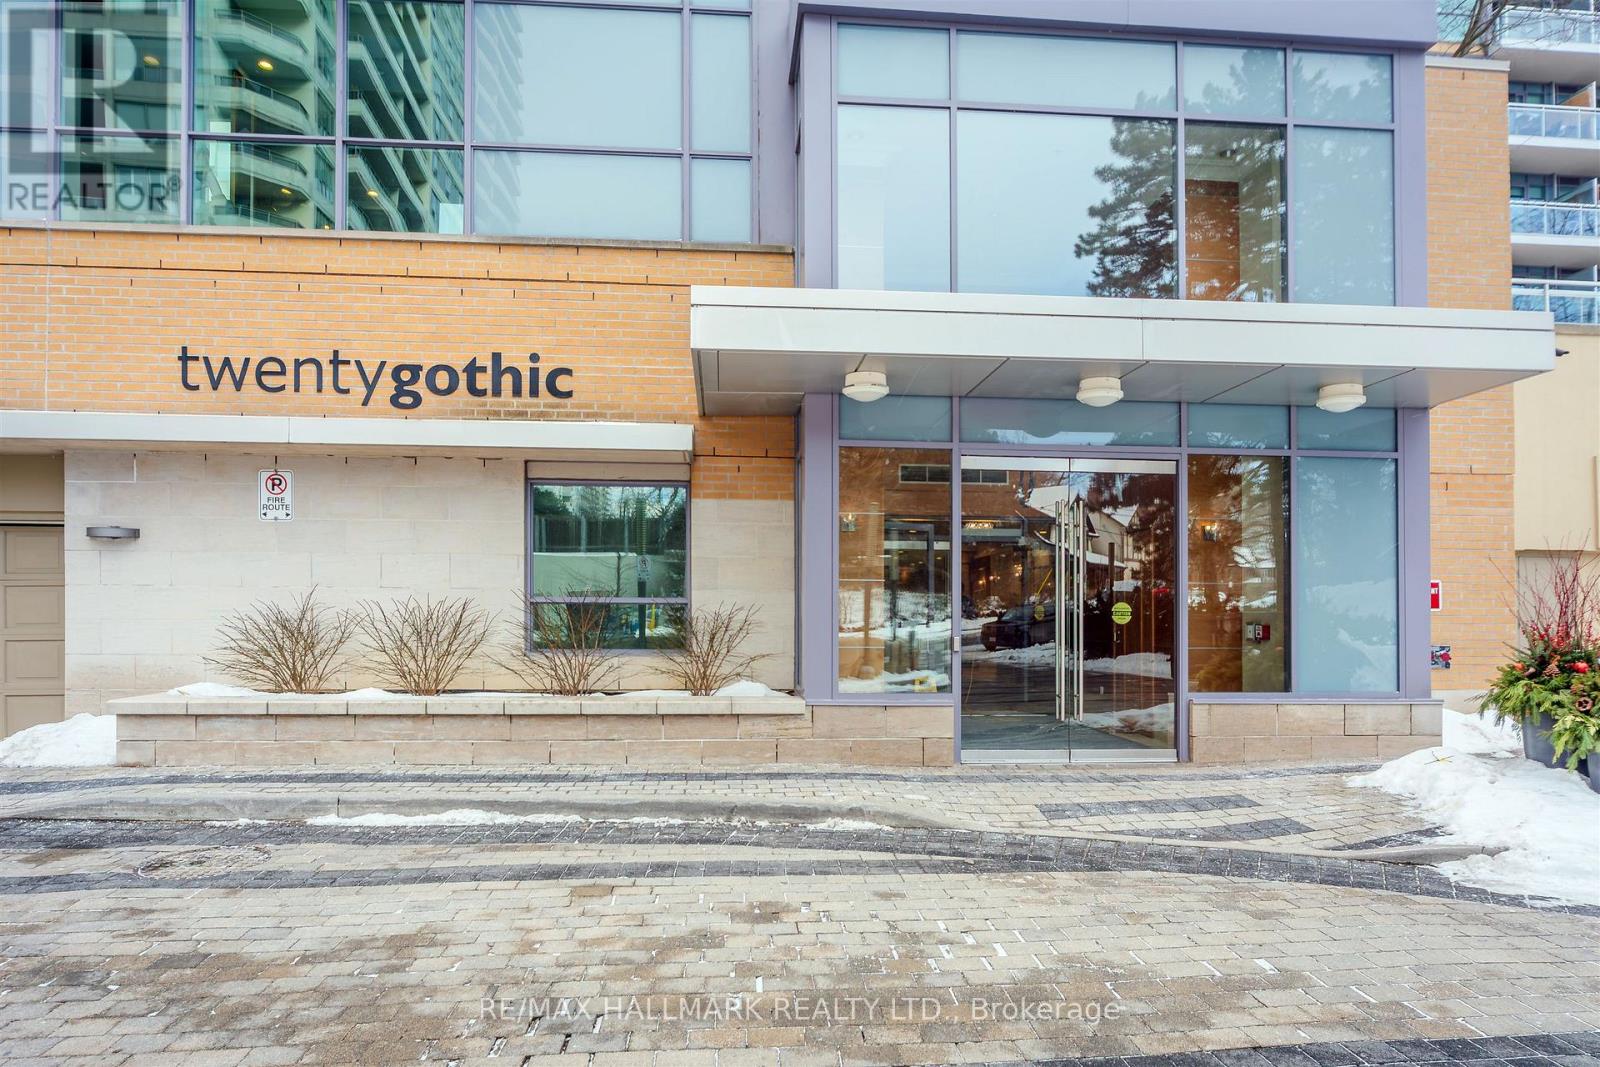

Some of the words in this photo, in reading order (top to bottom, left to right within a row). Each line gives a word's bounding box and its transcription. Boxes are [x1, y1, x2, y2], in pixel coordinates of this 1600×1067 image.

[177, 345, 574, 410] twentygothic
[267, 496, 286, 504] FIRE
[262, 503, 291, 511] ROUTE
